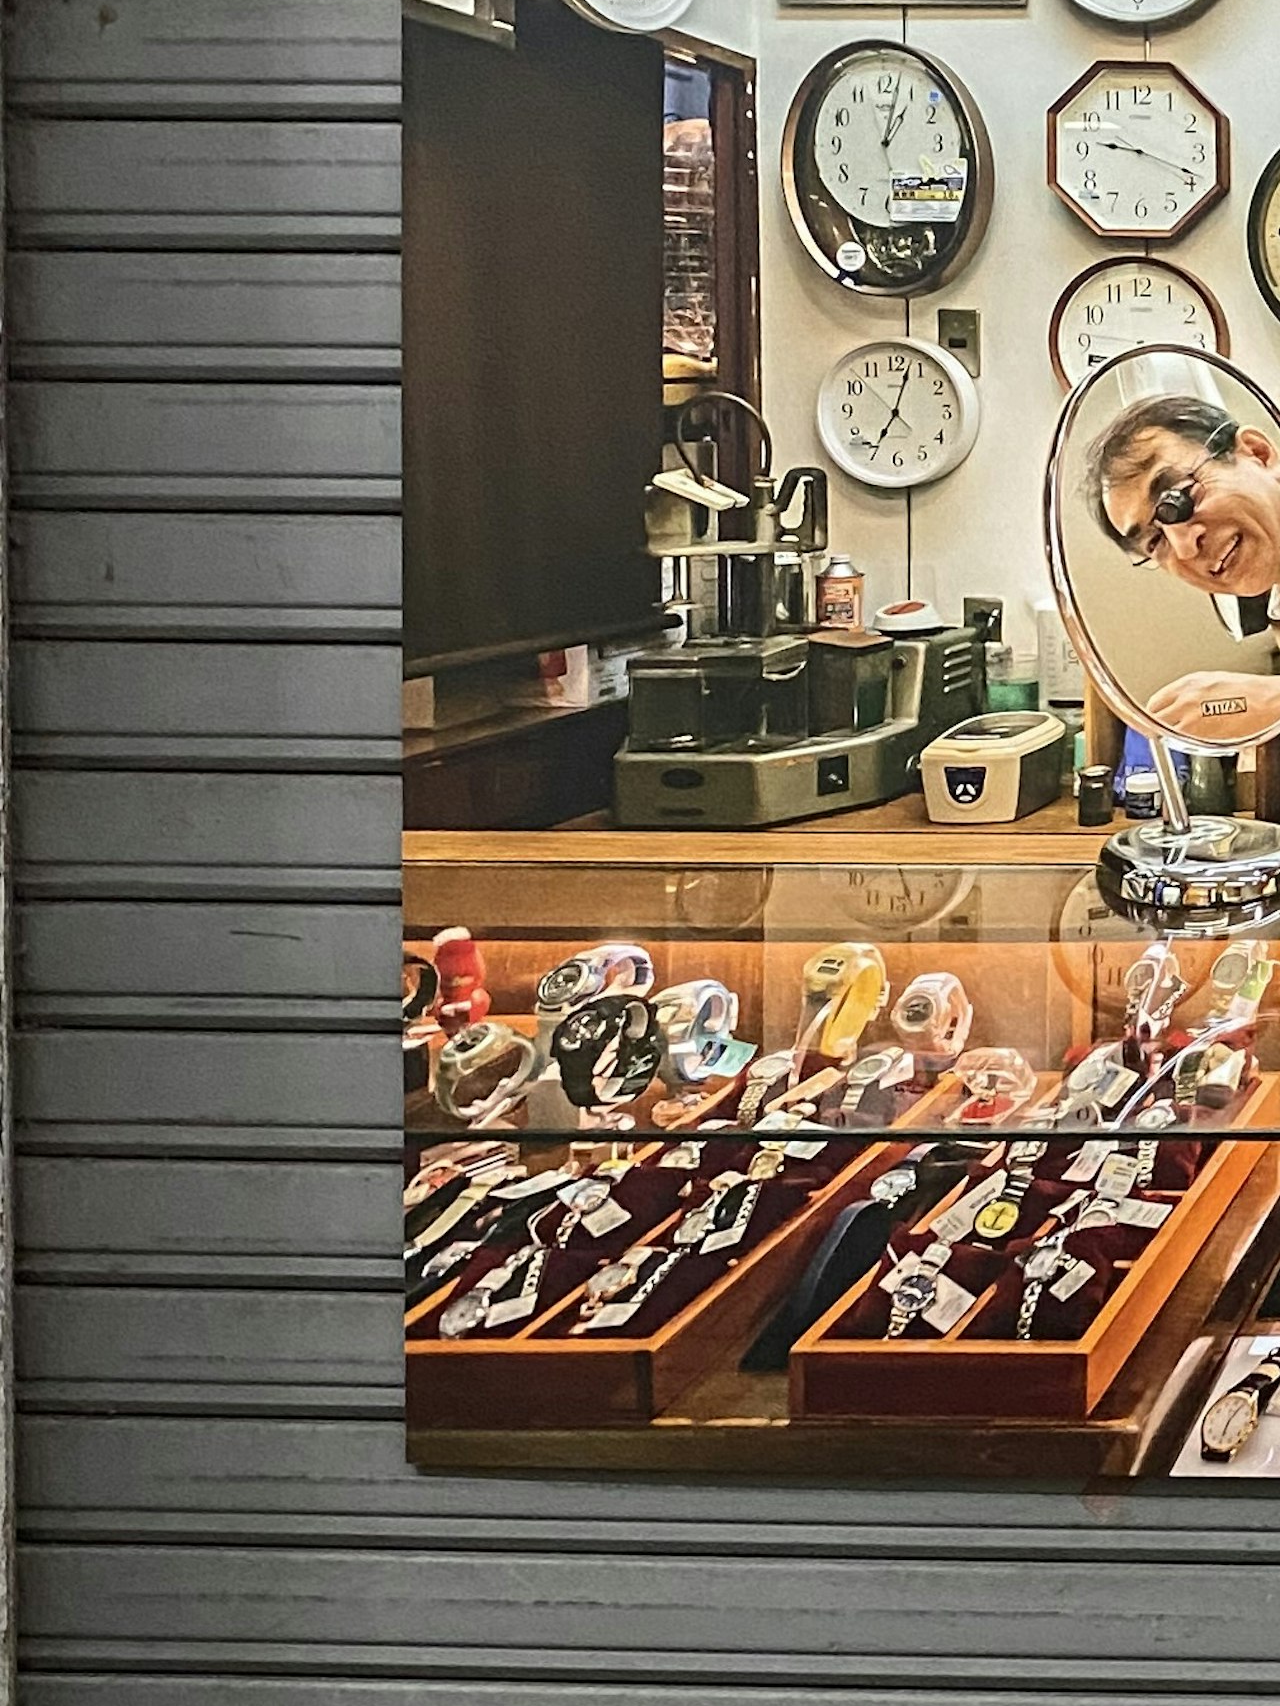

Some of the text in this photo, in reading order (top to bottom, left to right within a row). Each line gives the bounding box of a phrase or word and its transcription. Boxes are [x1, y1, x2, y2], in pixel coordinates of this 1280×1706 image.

[865, 362, 877, 377] 11
[888, 355, 904, 371] 12
[918, 363, 923, 378] 1
[847, 380, 862, 396] 10
[933, 381, 943, 395] 2
[842, 404, 853, 417] 9
[943, 405, 952, 419] 3
[934, 429, 943, 444] 4
[893, 452, 903, 466] 6
[918, 445, 927, 461] 5
